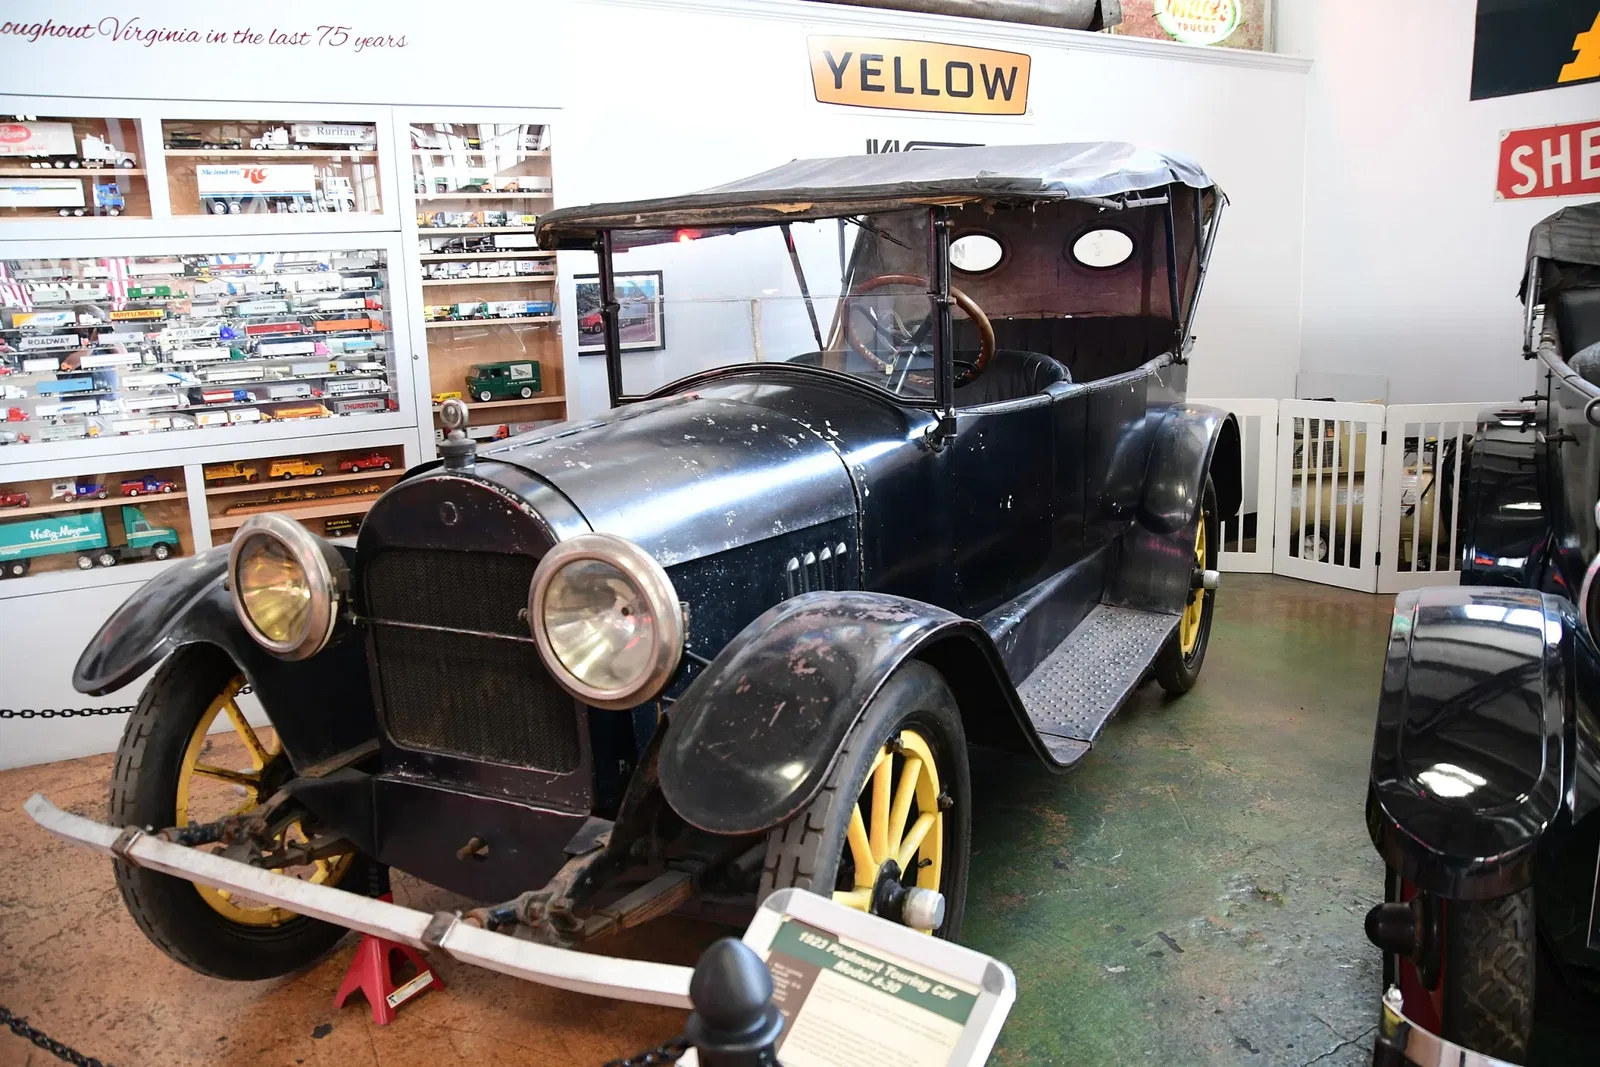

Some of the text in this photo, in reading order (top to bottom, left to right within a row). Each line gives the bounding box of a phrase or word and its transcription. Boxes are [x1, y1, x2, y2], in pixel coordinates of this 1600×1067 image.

[98, 16, 202, 48] Virginia
[206, 27, 229, 44] in
[232, 26, 265, 45] the
[268, 27, 311, 46] last
[315, 25, 353, 48] 75
[354, 33, 409, 53] years
[1177, 22, 1216, 34] TRUCKS
[822, 50, 1019, 102] YELLOW
[316, 126, 357, 137] Ruritan
[240, 167, 269, 185] RC
[112, 310, 156, 319] MAYFLOWER
[27, 337, 70, 346] ROADWAY
[343, 401, 379, 410] THURSTON
[832, 959, 874, 982] Model
[882, 962, 931, 995] Touring
[930, 982, 959, 1001] Car
